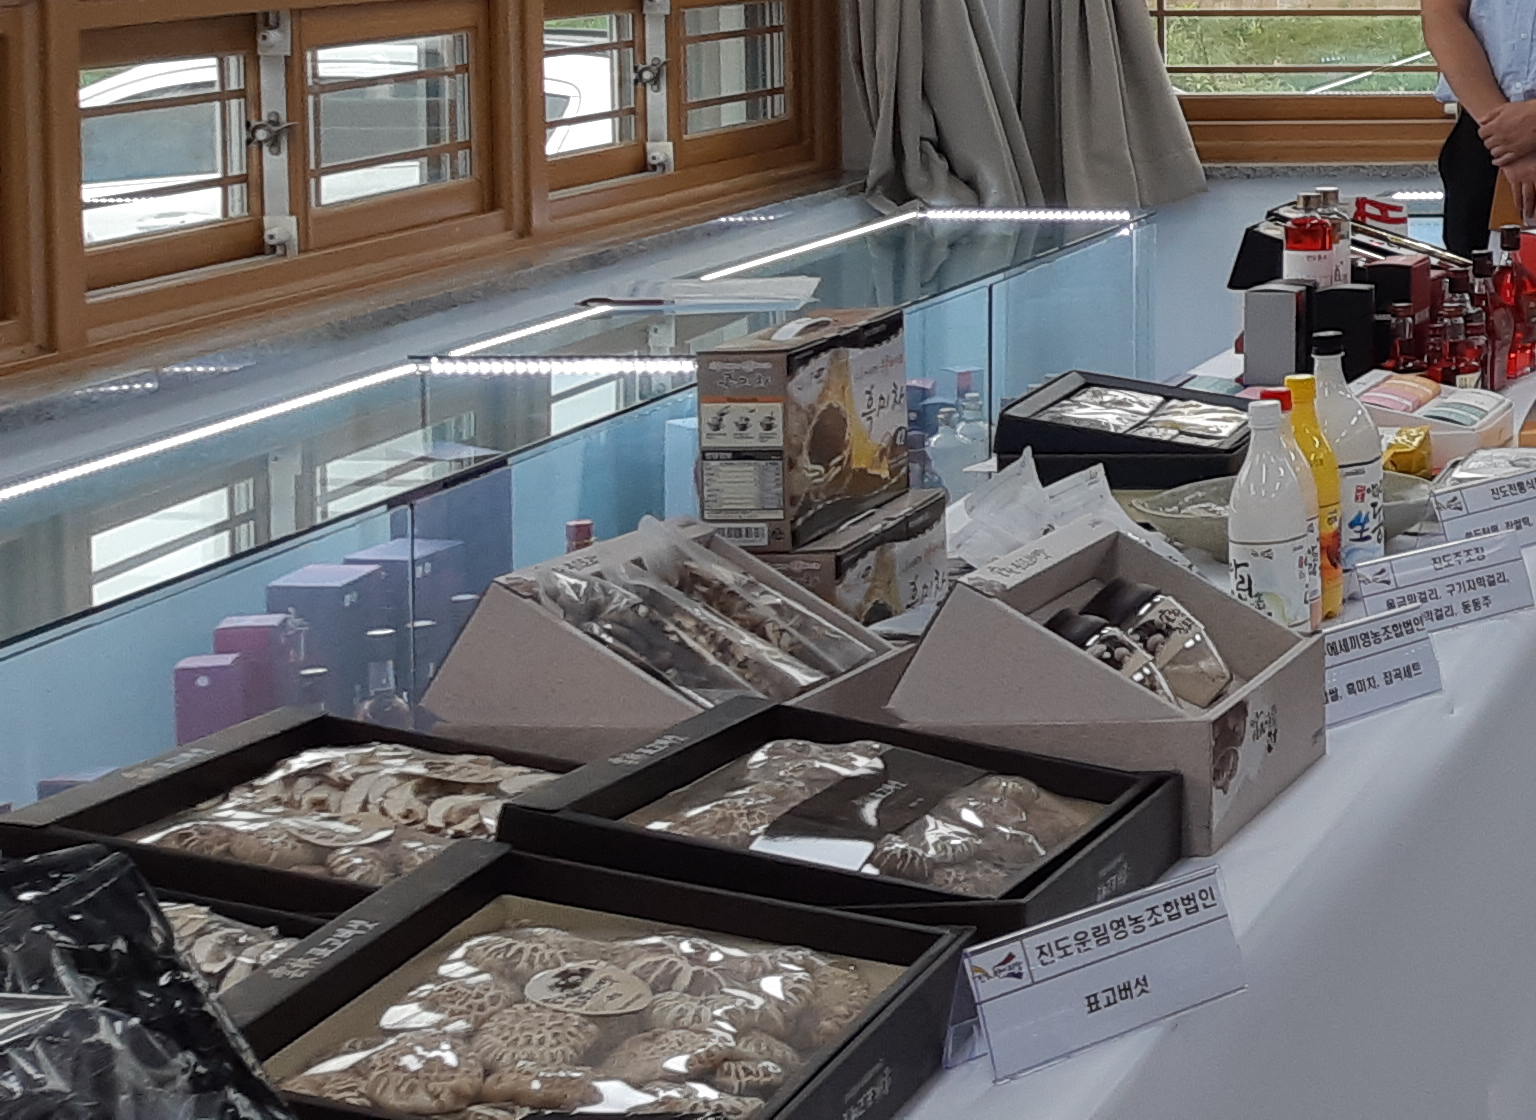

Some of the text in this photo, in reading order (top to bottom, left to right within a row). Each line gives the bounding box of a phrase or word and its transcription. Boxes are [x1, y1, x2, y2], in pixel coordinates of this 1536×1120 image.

[1431, 546, 1487, 571] 진도주조장
[1462, 595, 1492, 615] 동동주
[1035, 885, 1219, 968] 진도운림영농조합법인
[1084, 974, 1151, 1016] 표고버섯
